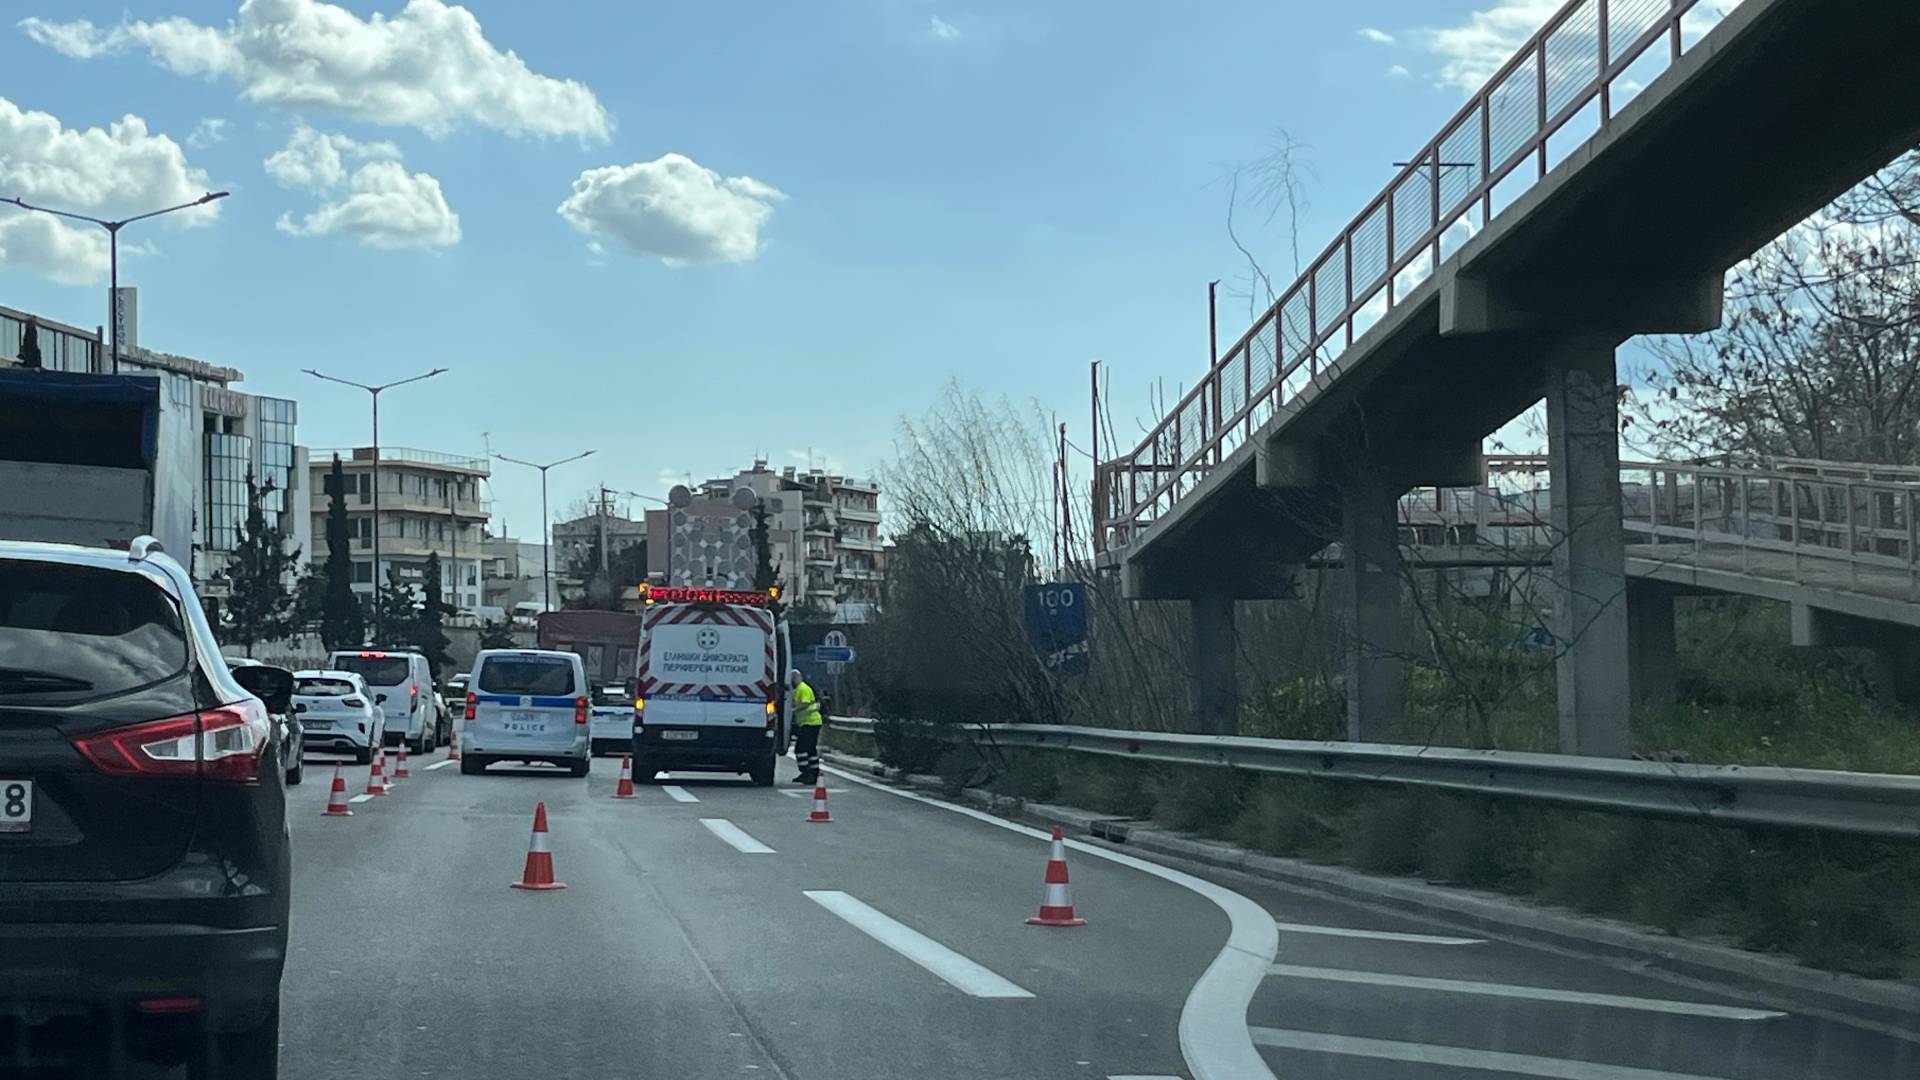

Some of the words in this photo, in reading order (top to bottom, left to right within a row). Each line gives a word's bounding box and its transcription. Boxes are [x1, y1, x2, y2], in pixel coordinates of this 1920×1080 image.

[1038, 589, 1074, 607] 100
[663, 651, 701, 662] ΕΛΛΗΝΙΚΗ
[702, 652, 749, 663] ΔΗΜΟΚΡΑΤΙΑ
[663, 663, 713, 673] ΠΕΡΙΦΕΡΕΙΑ
[715, 664, 749, 674] ΑΤΤΙΚΗΣ
[504, 723, 545, 731] POLICE
